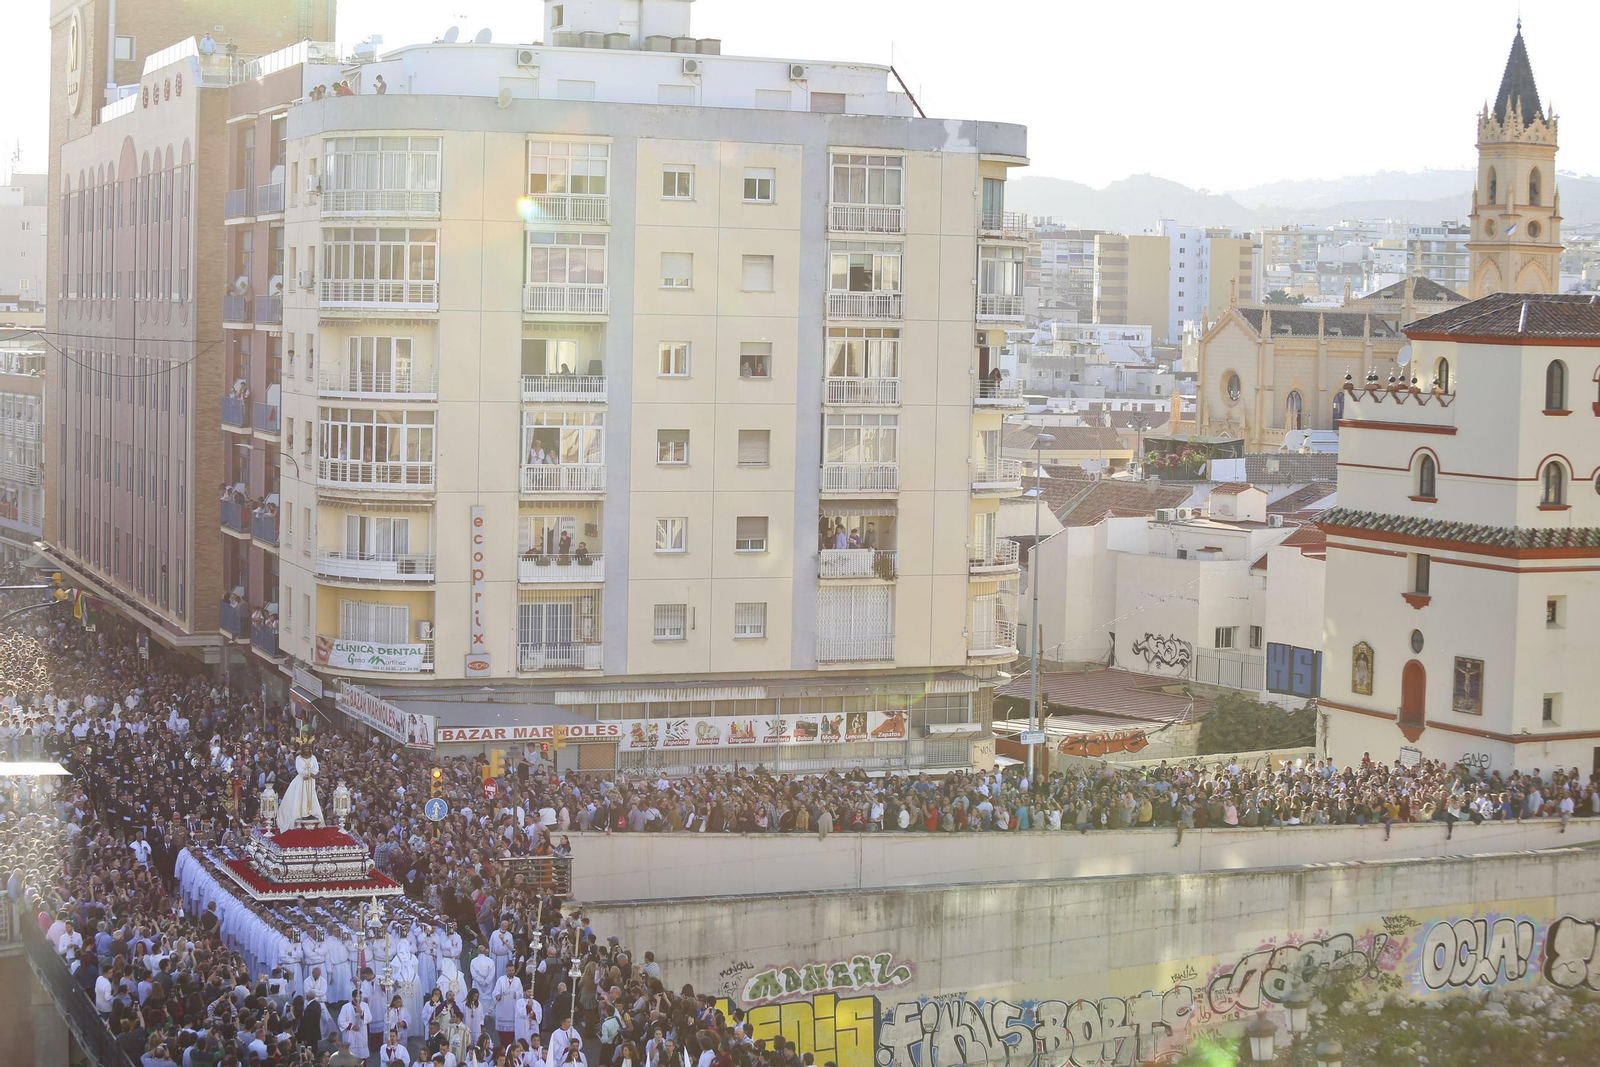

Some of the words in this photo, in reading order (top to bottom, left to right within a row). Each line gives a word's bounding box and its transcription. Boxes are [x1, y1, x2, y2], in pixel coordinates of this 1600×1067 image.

[377, 647, 424, 656] DENTAL
[442, 728, 506, 741] BAZAR
[513, 725, 619, 739] MAROLES
[877, 731, 901, 739] Zapatos
